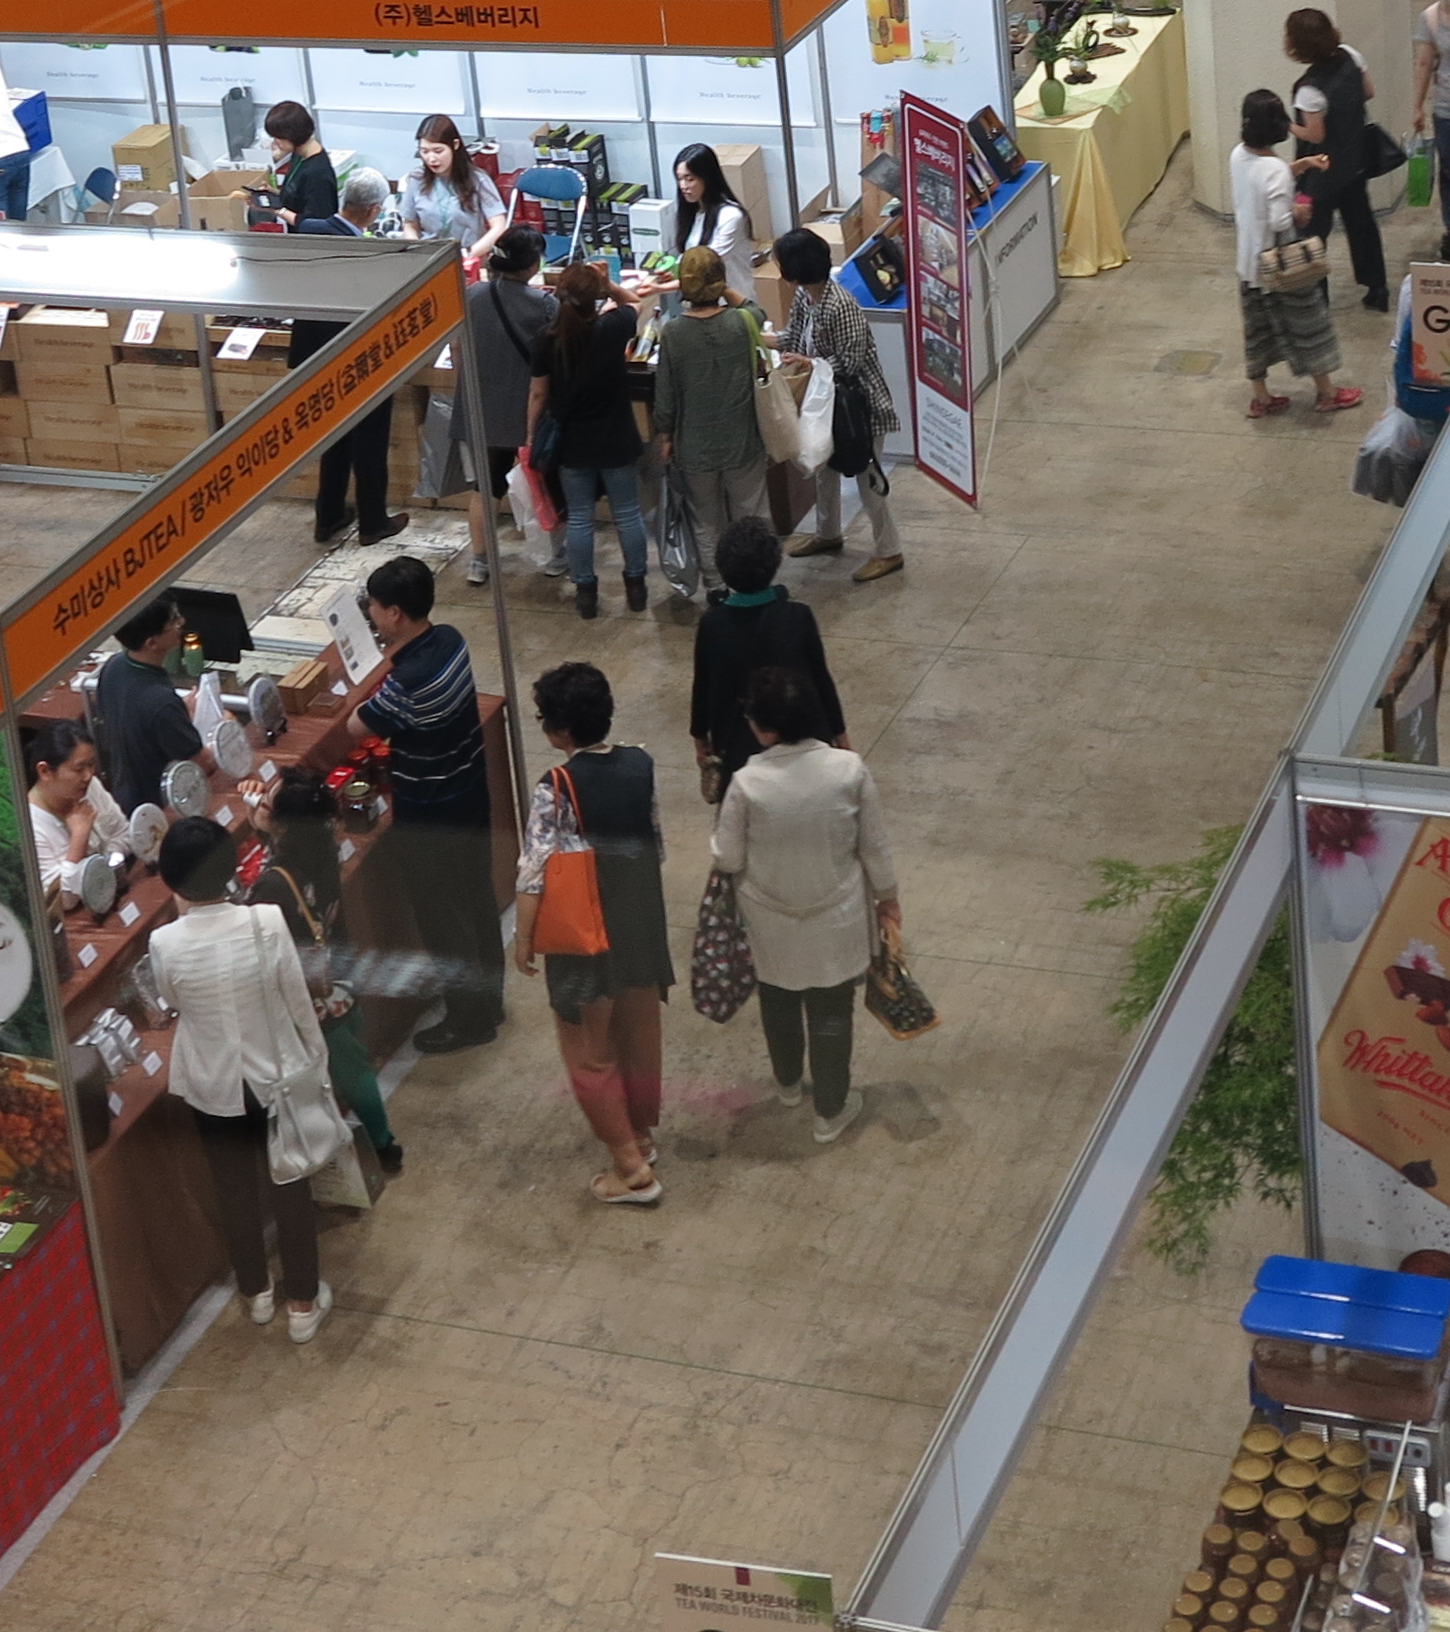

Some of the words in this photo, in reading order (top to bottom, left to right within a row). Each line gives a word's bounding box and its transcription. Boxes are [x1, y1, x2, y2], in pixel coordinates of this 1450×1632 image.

[373, 1, 540, 31] (주)헬스베버리지
[51, 554, 121, 637] 수미상사
[122, 510, 180, 580] BJTEA
[188, 465, 234, 524] 광저우
[282, 423, 293, 447] &
[294, 393, 336, 432] 옥명당
[673, 1581, 717, 1600] 제15회
[675, 1597, 700, 1611] TEA
[701, 1600, 740, 1617] WORLD
[741, 1604, 792, 1623] FESTIVAL
